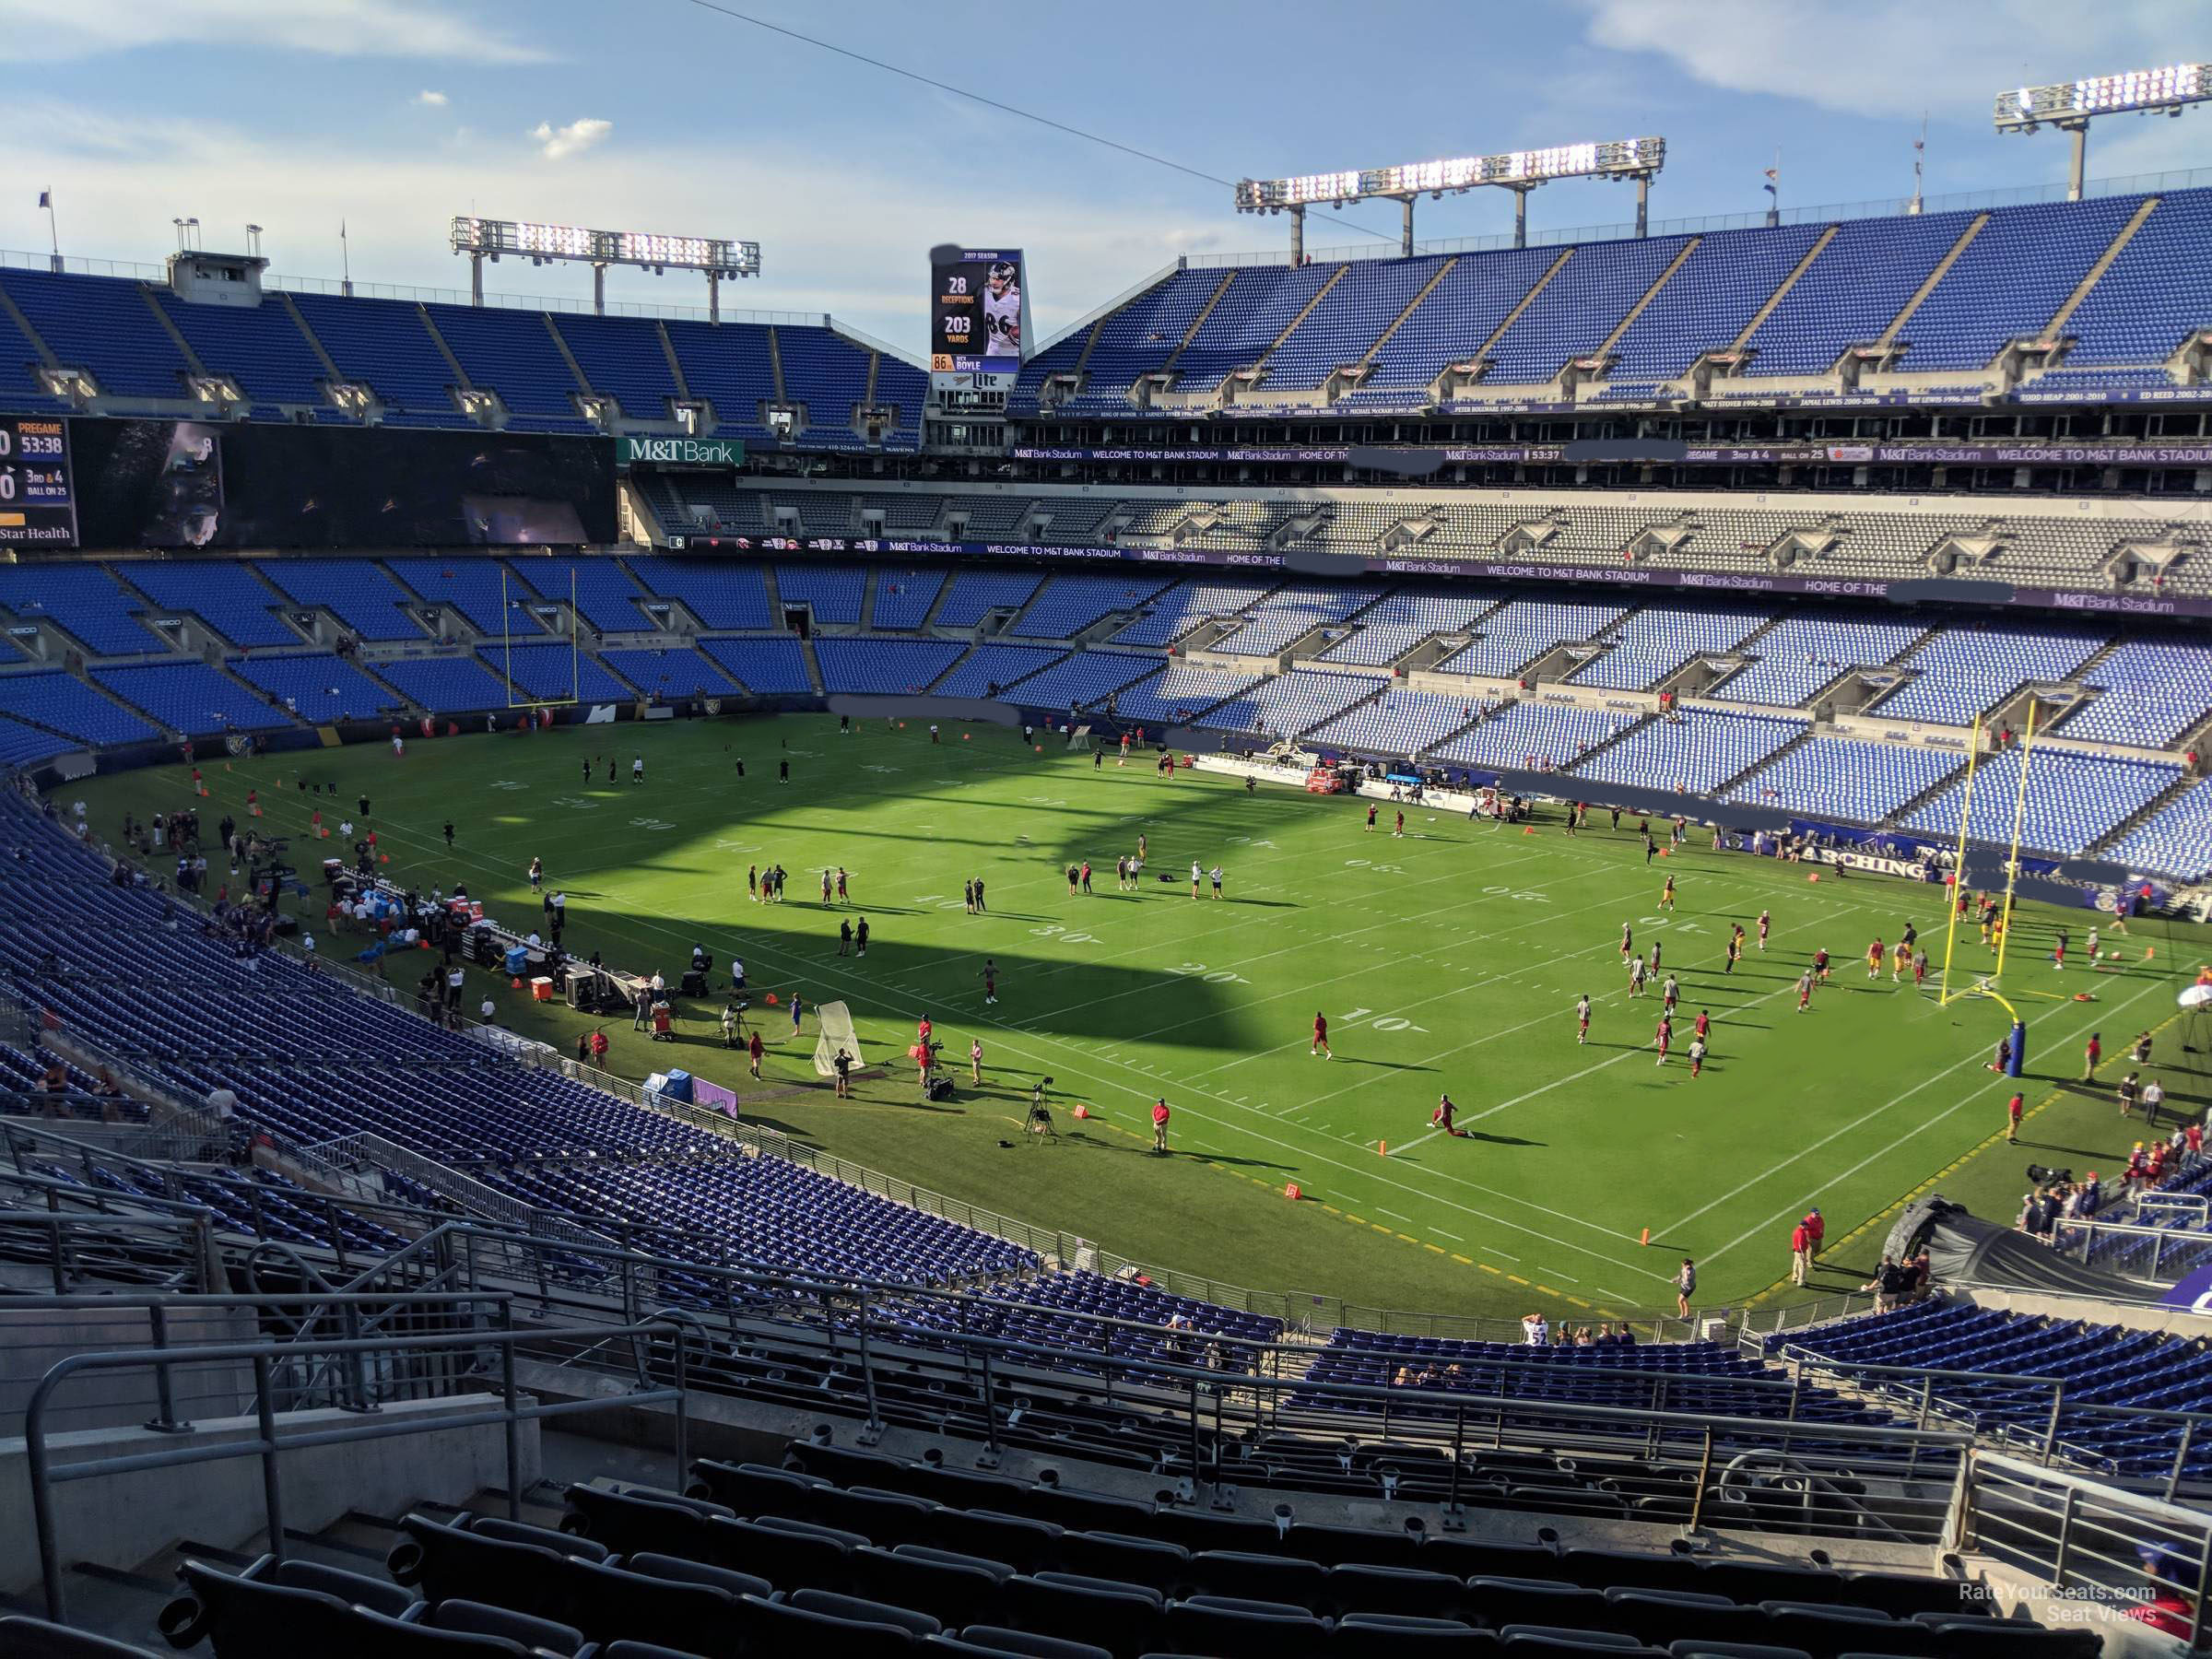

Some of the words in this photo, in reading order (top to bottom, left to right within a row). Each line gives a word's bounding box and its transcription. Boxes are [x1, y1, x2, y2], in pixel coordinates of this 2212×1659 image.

[948, 276, 967, 294] 28
[941, 295, 974, 304] RECEPTIONS
[945, 316, 971, 334] 203
[947, 335, 969, 344] YARDS
[934, 356, 947, 370] 86
[956, 360, 981, 371] BOYLE
[972, 372, 997, 389] Lite
[2140, 392, 2152, 400] ED
[2153, 391, 2174, 399] REED
[2175, 390, 2212, 398] 2002-20
[18, 422, 63, 435] PREGAME
[21, 436, 64, 453] 53:38
[629, 439, 683, 461] M&T
[684, 440, 734, 463] Bank
[1015, 448, 1034, 459] M&T
[1034, 449, 1052, 459] Bank
[1052, 450, 1082, 460] Stadium
[1092, 450, 1132, 460] WELCOME
[1133, 451, 1145, 460] TO
[1146, 451, 1163, 460] M&T
[1164, 451, 1185, 460] BANK
[1186, 451, 1218, 460] STADIUM
[1227, 450, 1246, 460] M&T
[1246, 451, 1263, 460] Bank
[1263, 451, 1291, 461] Stadium
[1299, 451, 1323, 460] HOME
[1324, 451, 1336, 460] OF
[1336, 451, 1348, 460] TH
[1445, 450, 1467, 461] M&T
[1466, 450, 1487, 461] Bank
[1487, 450, 1520, 461] Stadium
[1532, 450, 1560, 460] 53:37
[1686, 450, 1718, 460] REGAME
[1761, 449, 1769, 460] 4
[1811, 450, 1825, 460] 25
[1879, 448, 1908, 462] M&T
[1907, 449, 1935, 462] Bank
[1936, 450, 1982, 463] Stadium
[1996, 448, 2063, 462] WELCOME
[2064, 448, 2085, 462] TO
[2086, 448, 2117, 462] M&T
[2118, 449, 2158, 463] BANK
[0, 474, 16, 500] 0
[26, 469, 45, 484] 3RD
[45, 472, 54, 484] &
[54, 469, 64, 484] 4
[27, 487, 45, 496] BALL
[45, 487, 57, 496] ON
[57, 488, 66, 496] 25
[0, 528, 26, 539] Star
[28, 526, 71, 539] Health
[889, 541, 910, 552] M&T
[910, 542, 930, 553] Bank
[930, 543, 962, 554] Stadium
[986, 545, 1029, 555] WELCOME
[1030, 547, 1042, 555] TO
[1043, 547, 1062, 556] M&T
[1063, 548, 1085, 557] BANK
[1086, 548, 1121, 559] STADIUM
[1142, 550, 1159, 560] M&T
[1159, 551, 1177, 561] Bank
[1177, 552, 1206, 562] Stadium
[1227, 554, 1250, 563] HOME
[1251, 555, 1264, 564] OF
[1265, 556, 1281, 565] THE
[1385, 560, 1407, 571] M&T
[1406, 561, 1427, 572] Bank
[1428, 562, 1460, 574] Stadium
[1487, 565, 1535, 577] WELCOME
[1537, 567, 1551, 577] TO
[1553, 567, 1573, 579] M&T
[1575, 569, 1603, 580] BANK
[1605, 570, 1650, 582] STADIUM
[1680, 573, 1707, 586] M&T
[1706, 574, 1731, 587] Bank
[1731, 575, 1773, 590] Stadium
[1805, 580, 1841, 593] HOME
[1842, 582, 1861, 594] OF
[1864, 582, 1888, 594] THE
[2053, 593, 2088, 608] M&T
[2088, 595, 2120, 610] Bank
[2122, 596, 2174, 613] Stadium
[1028, 924, 1093, 944] 30
[1163, 961, 1239, 983] 20
[1334, 1006, 1411, 1031] 10
